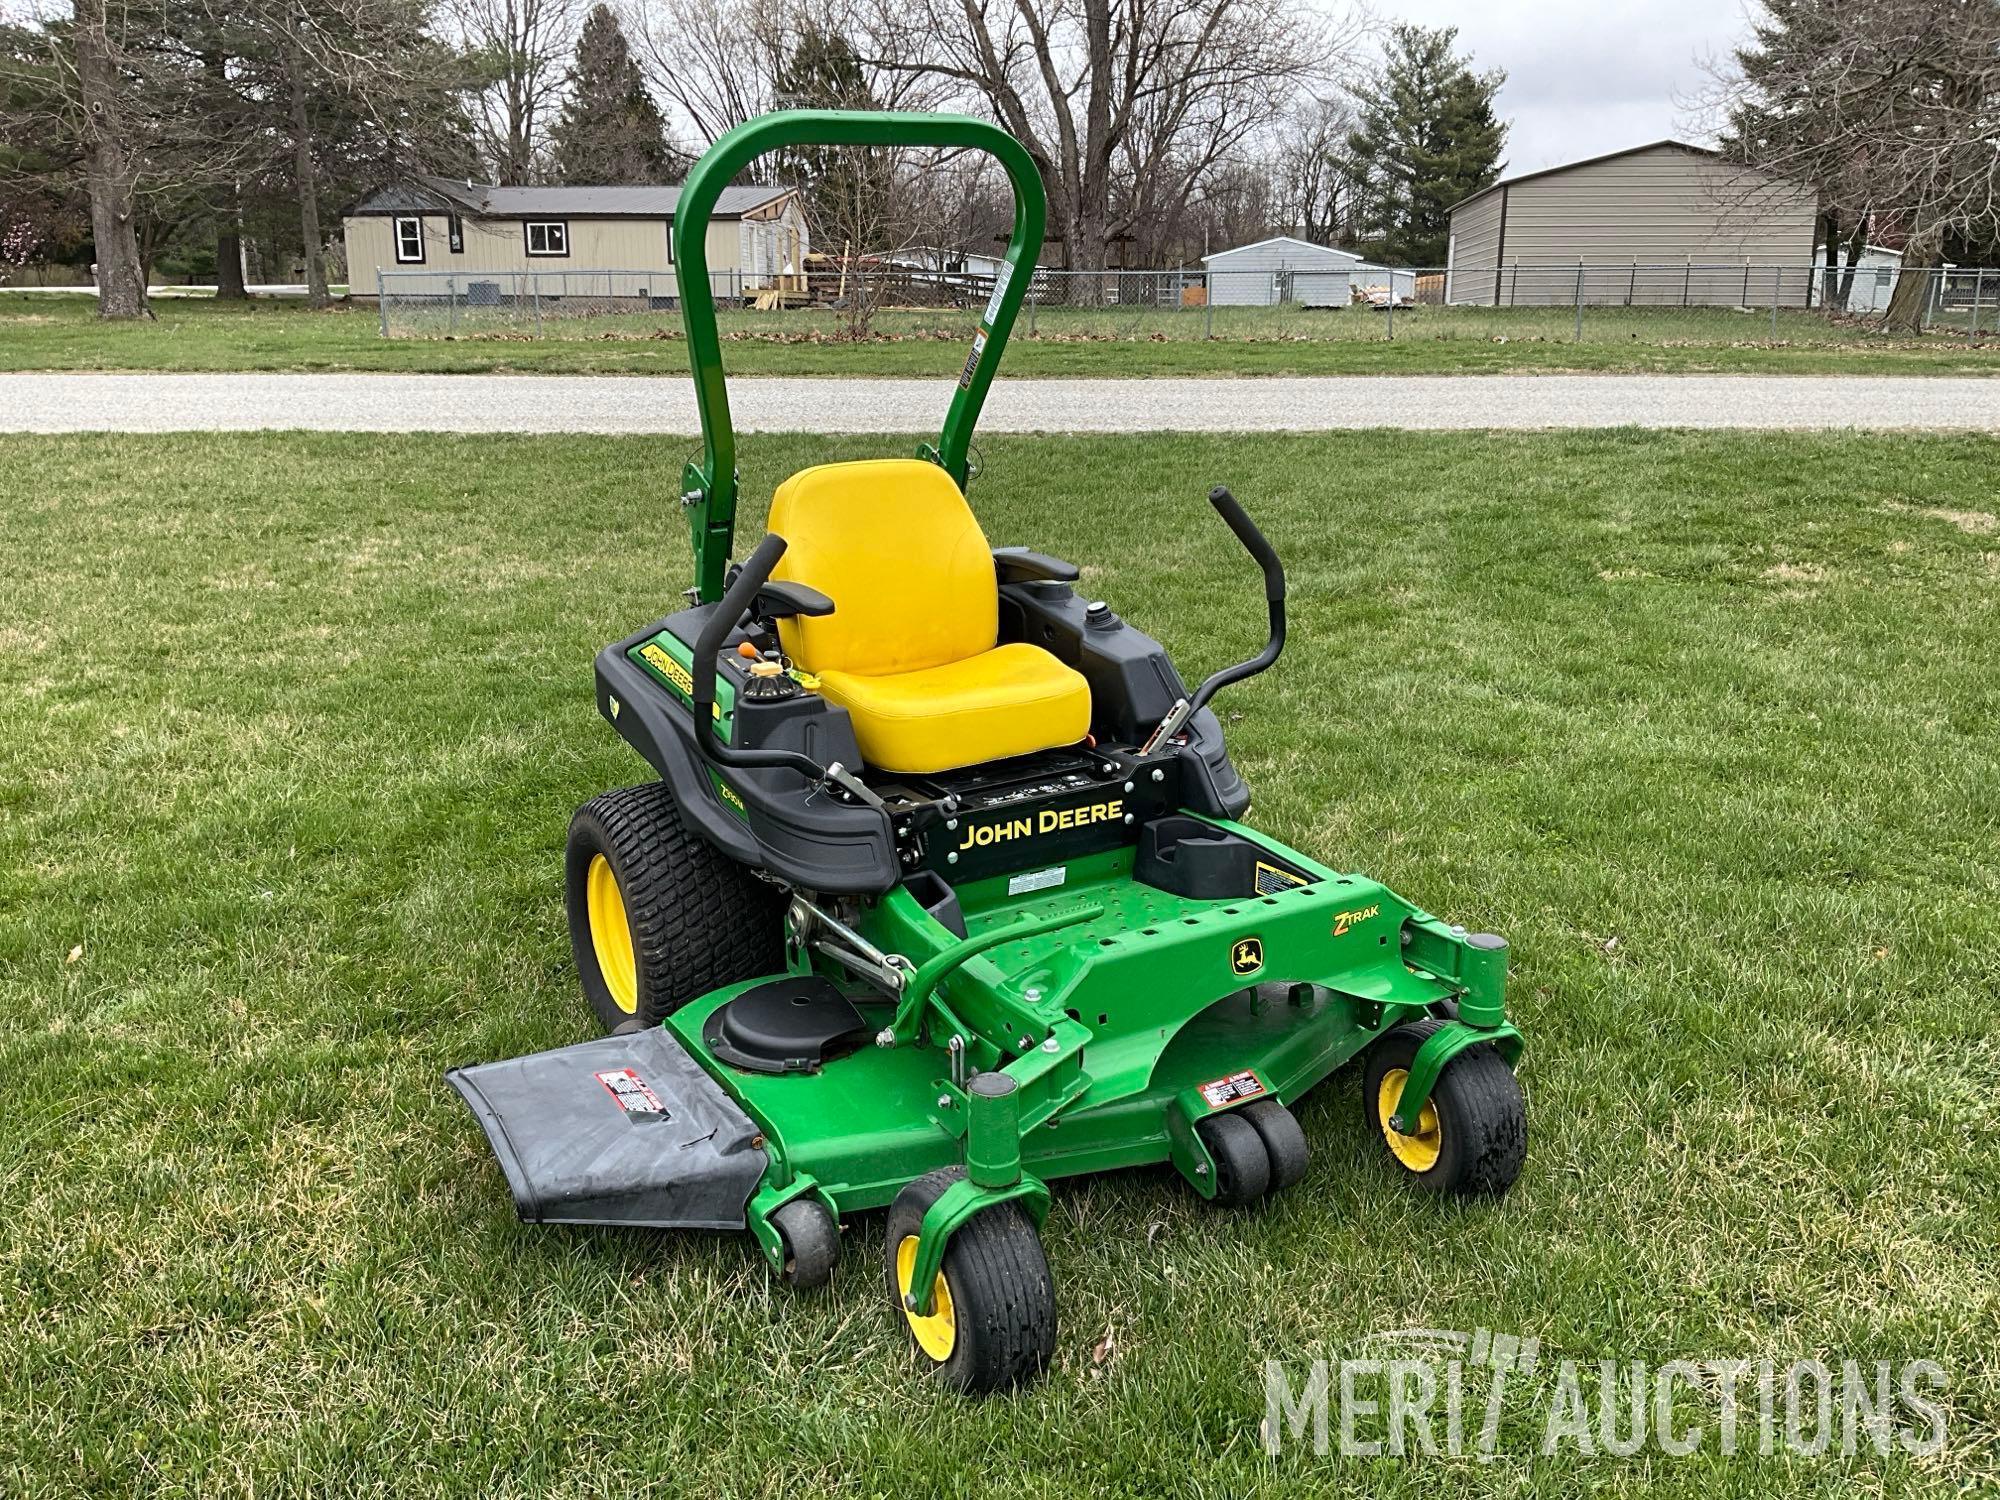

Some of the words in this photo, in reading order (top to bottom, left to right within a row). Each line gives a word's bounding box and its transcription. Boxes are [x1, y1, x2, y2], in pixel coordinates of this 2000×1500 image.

[645, 648, 669, 674] JOHN
[959, 817, 1032, 850] JOHN
[1038, 799, 1123, 834] DEERE
